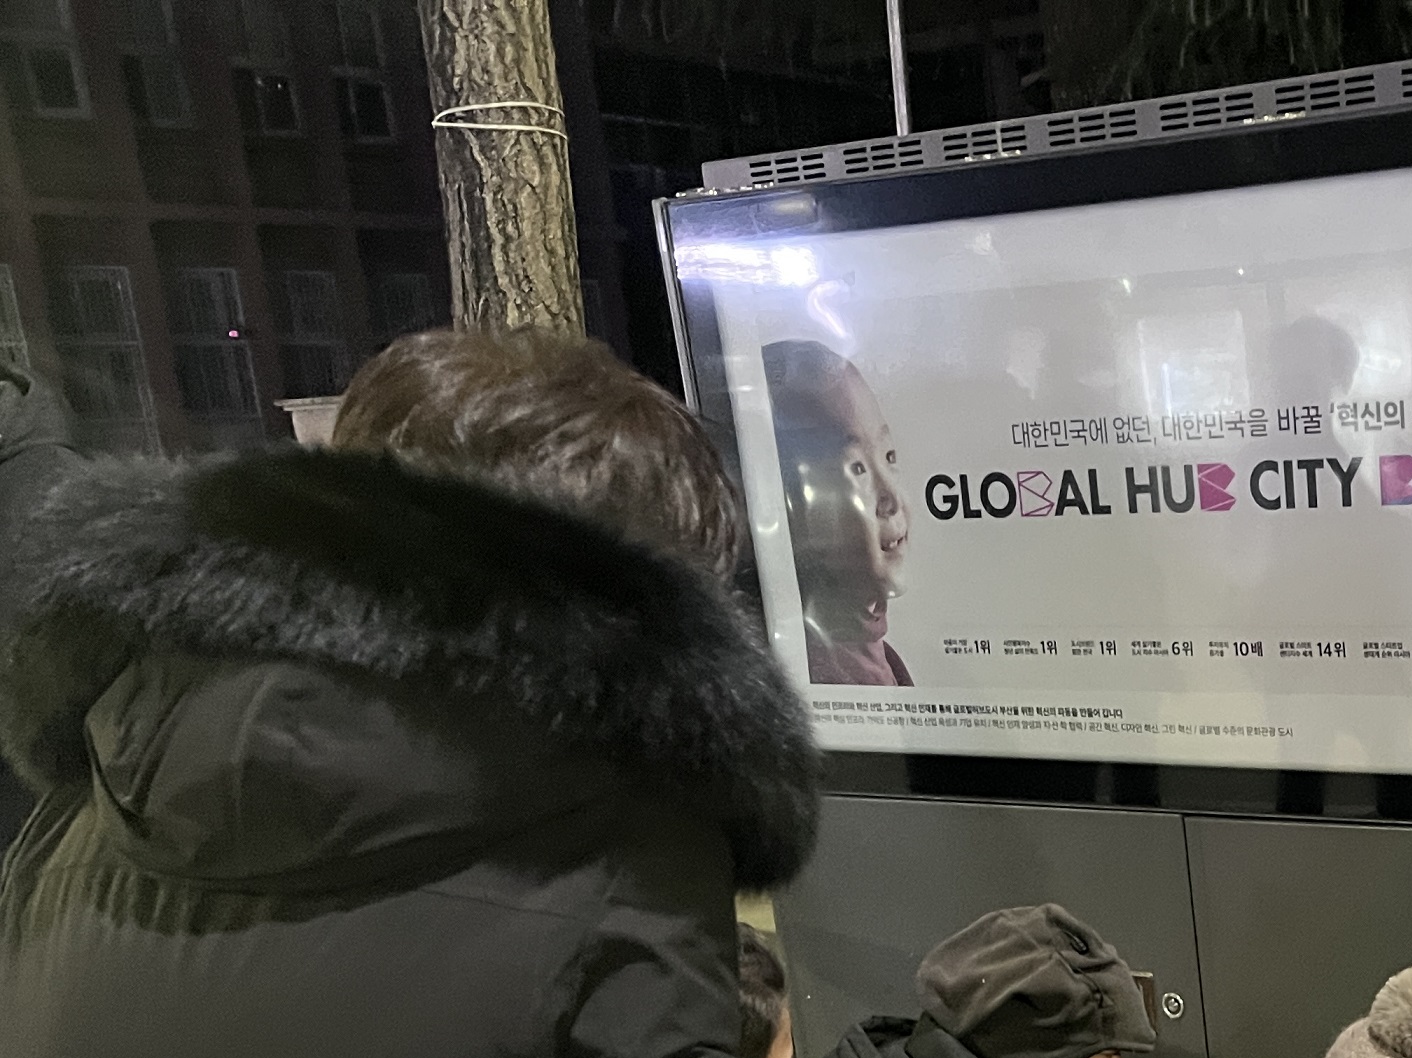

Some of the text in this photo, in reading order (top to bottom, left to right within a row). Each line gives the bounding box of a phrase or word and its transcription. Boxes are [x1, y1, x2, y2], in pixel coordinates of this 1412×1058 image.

[1011, 420, 1109, 449] 대한민국에
[1112, 417, 1158, 446] 없던,
[1161, 408, 1269, 443] 대한민국을
[1277, 404, 1323, 435] 바꿀
[924, 467, 1112, 521] GLOBAL
[1126, 462, 1238, 514] HUB
[1250, 456, 1363, 510] CITY
[974, 639, 991, 655] 1위
[1040, 640, 1058, 656] 1위
[1099, 640, 1117, 656] 1위
[1171, 640, 1194, 657] 6위
[1233, 641, 1264, 658] 10배
[1316, 641, 1347, 658] 14위
